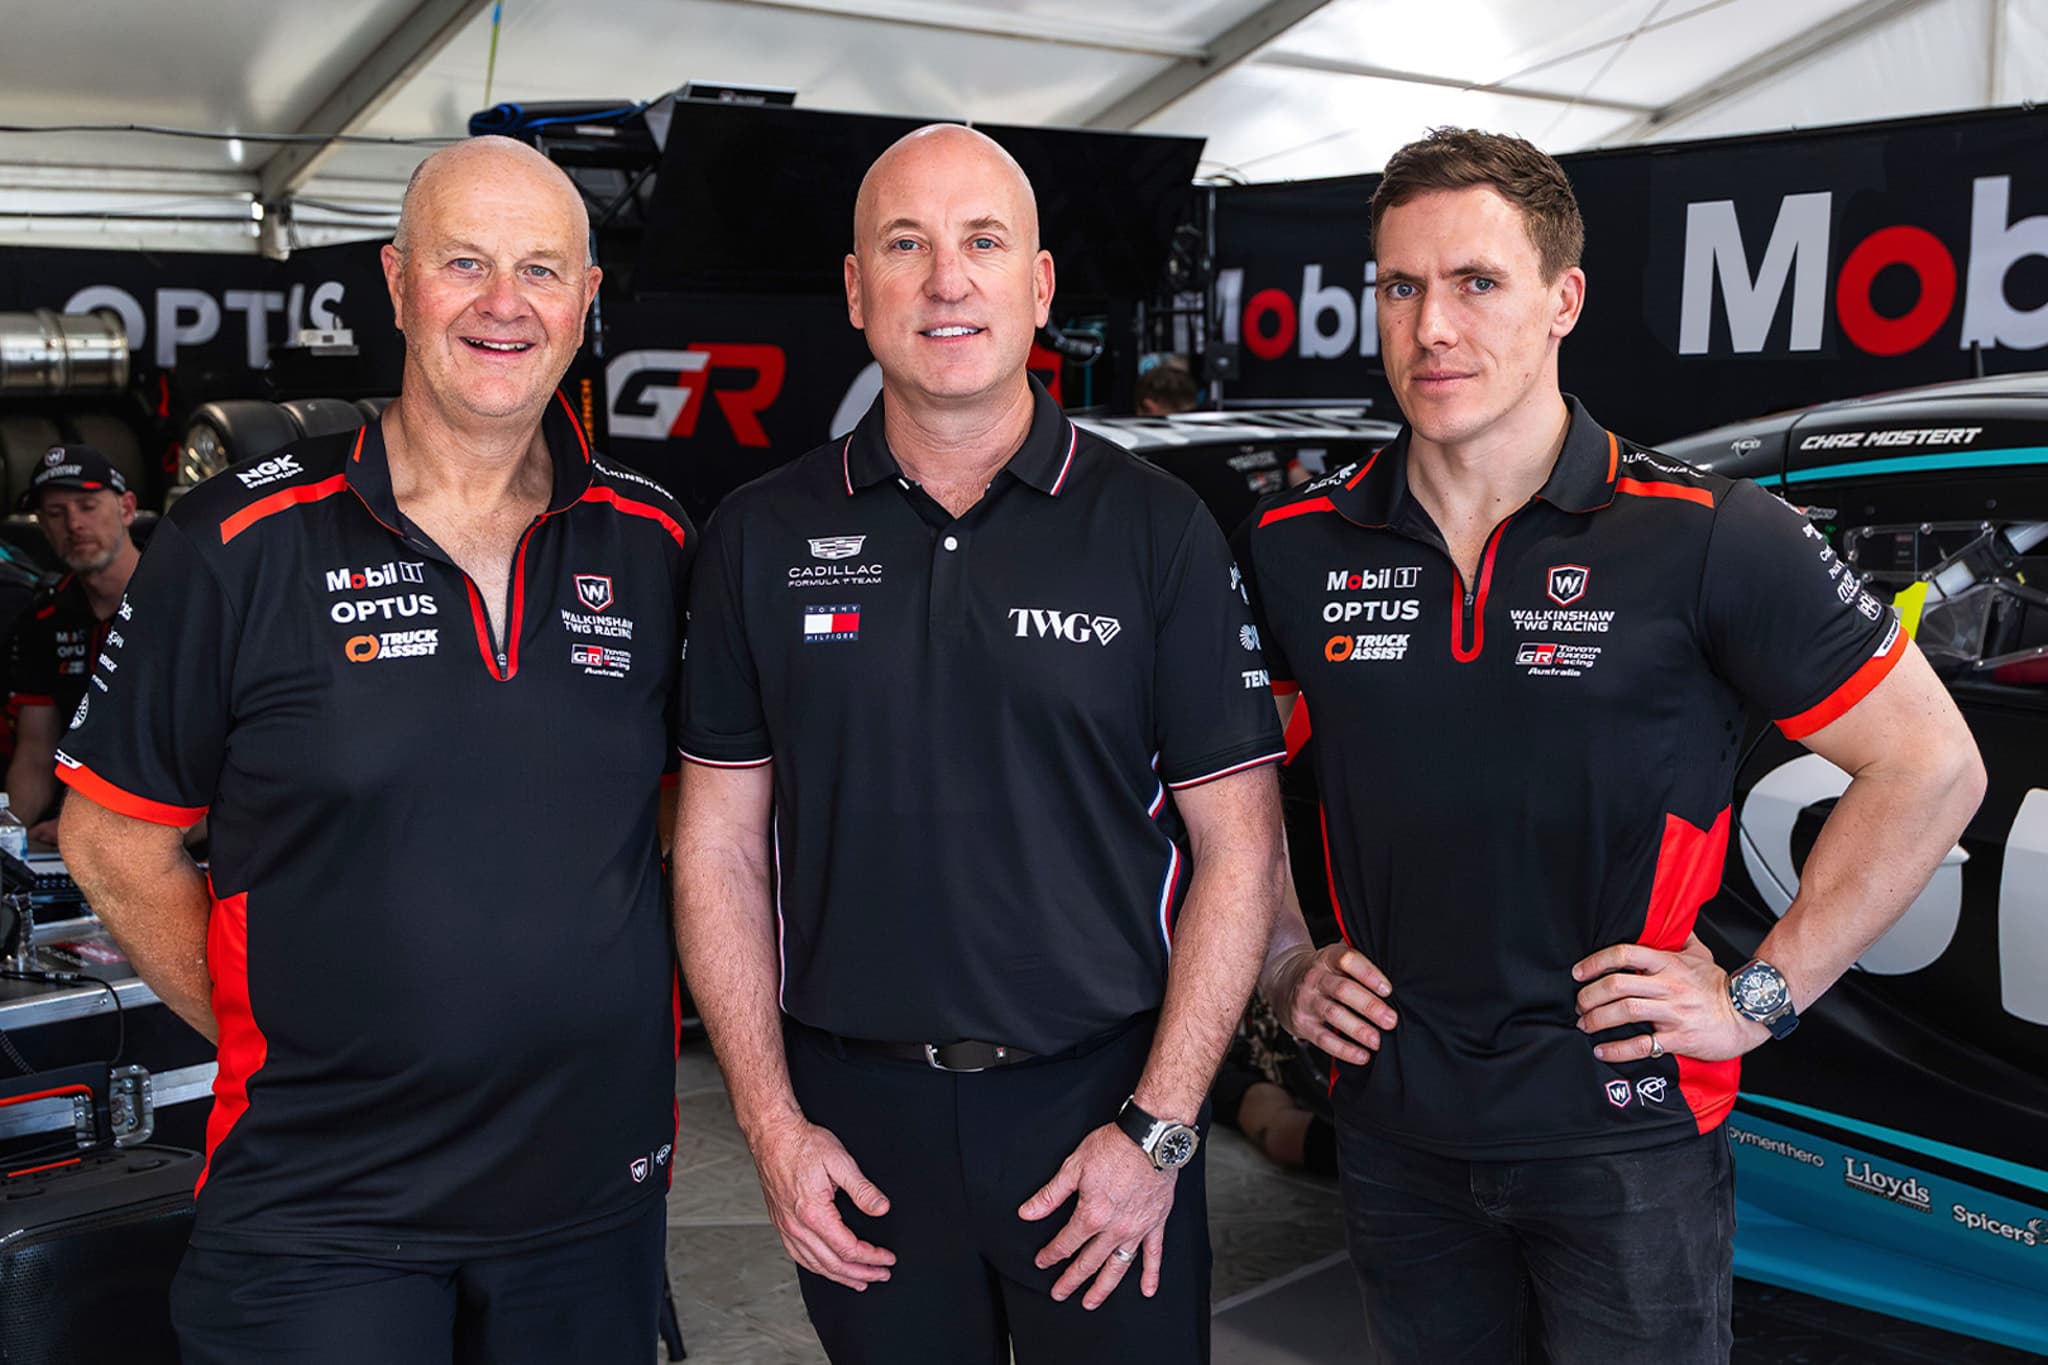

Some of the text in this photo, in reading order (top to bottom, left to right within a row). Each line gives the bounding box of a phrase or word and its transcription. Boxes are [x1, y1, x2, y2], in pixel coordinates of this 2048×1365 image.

[605, 342, 787, 449] GR
[1801, 427, 1983, 450] CHAZ MOSTERT
[235, 453, 300, 485] NGK
[325, 562, 398, 592] Mobil
[787, 563, 884, 579] CADILLAC
[1326, 568, 1392, 591] Mobil
[787, 579, 840, 588] FORMULA
[851, 577, 883, 585] TEAM
[1555, 575, 1582, 594] W
[581, 583, 606, 601] W
[330, 594, 438, 624] OPTUS
[808, 605, 859, 614] TOMMY
[1322, 599, 1420, 623] OPTUS
[1509, 609, 1616, 622] WALKINSHAW
[563, 620, 592, 634] TWG
[1007, 607, 1092, 644] TWG
[1513, 620, 1609, 633] TWG RACING
[380, 628, 439, 646] TRUCK
[805, 632, 855, 642] HILFIGER
[1355, 633, 1411, 648] TRUCK
[377, 642, 439, 660] ASSIST
[573, 651, 601, 665] GR
[1349, 646, 1407, 661] ASSIST
[1518, 650, 1554, 664] GR
[1558, 644, 1602, 654] TOYOTA
[1527, 666, 1582, 678] Australia
[1844, 1156, 1931, 1203] Lloyds
[1953, 1204, 2036, 1246] Spicers
